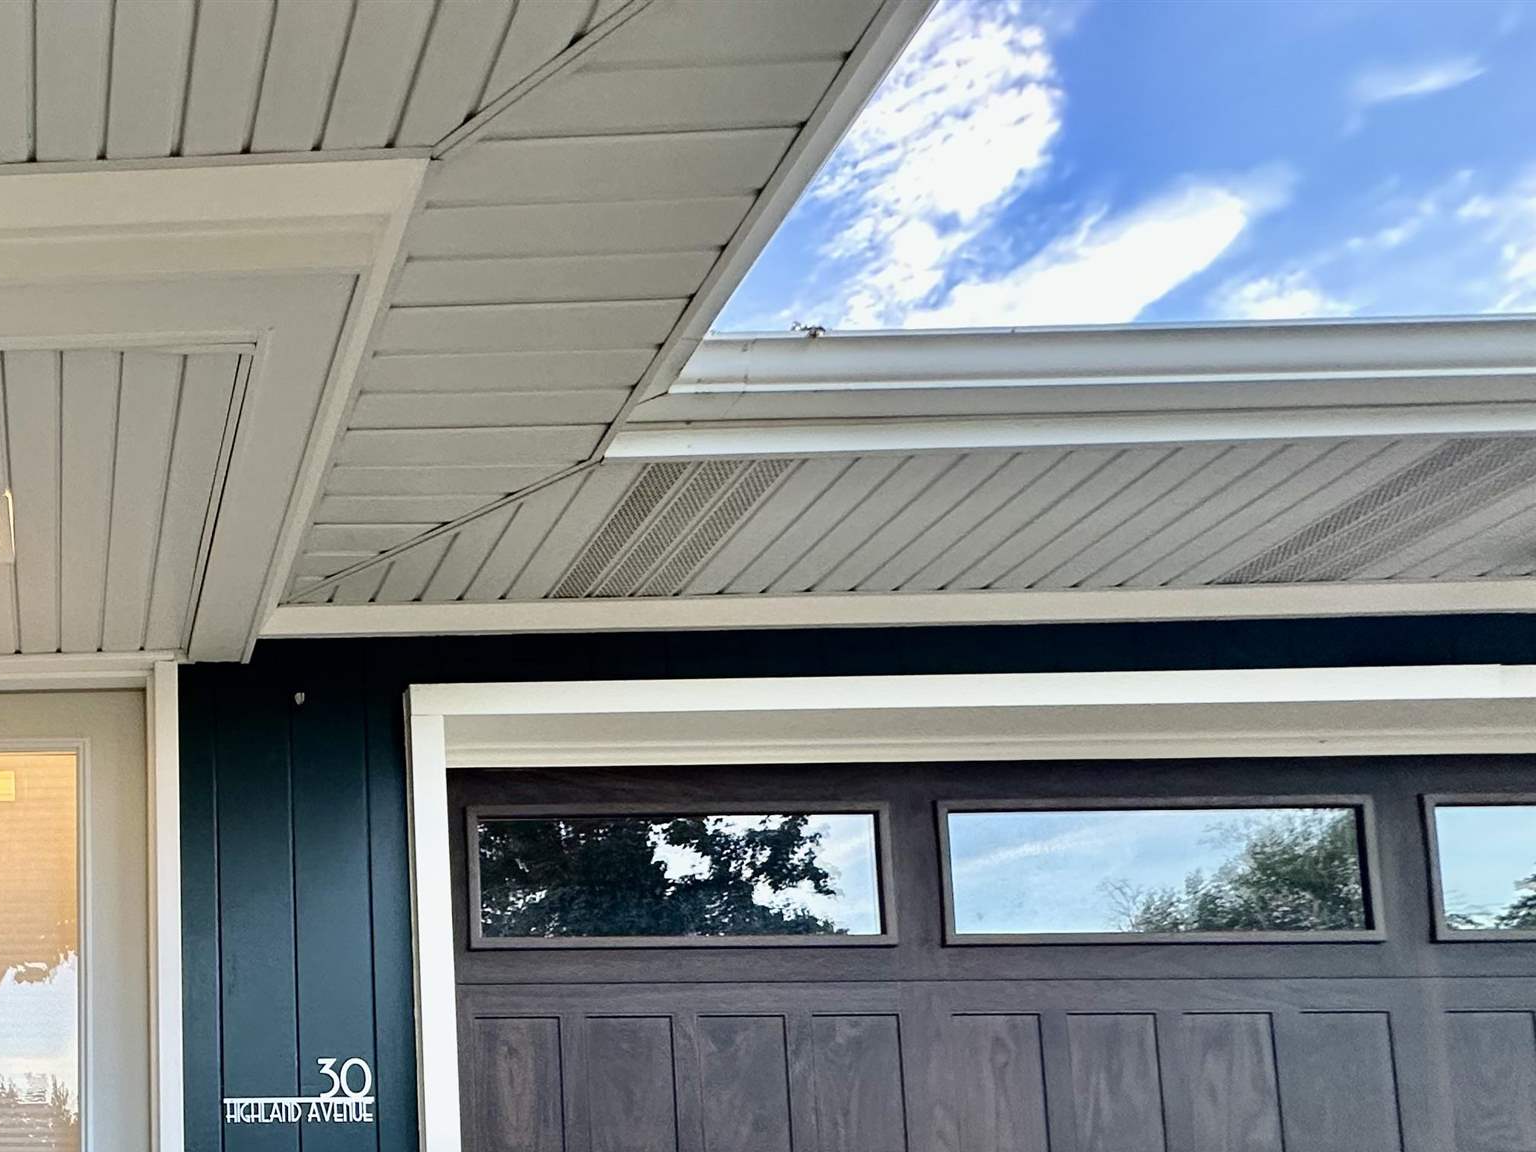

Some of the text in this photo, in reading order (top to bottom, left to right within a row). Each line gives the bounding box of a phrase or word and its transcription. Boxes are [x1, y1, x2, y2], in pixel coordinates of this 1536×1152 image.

[317, 1057, 373, 1099] 30
[225, 1101, 374, 1123] HIGHLAND AVENUE
